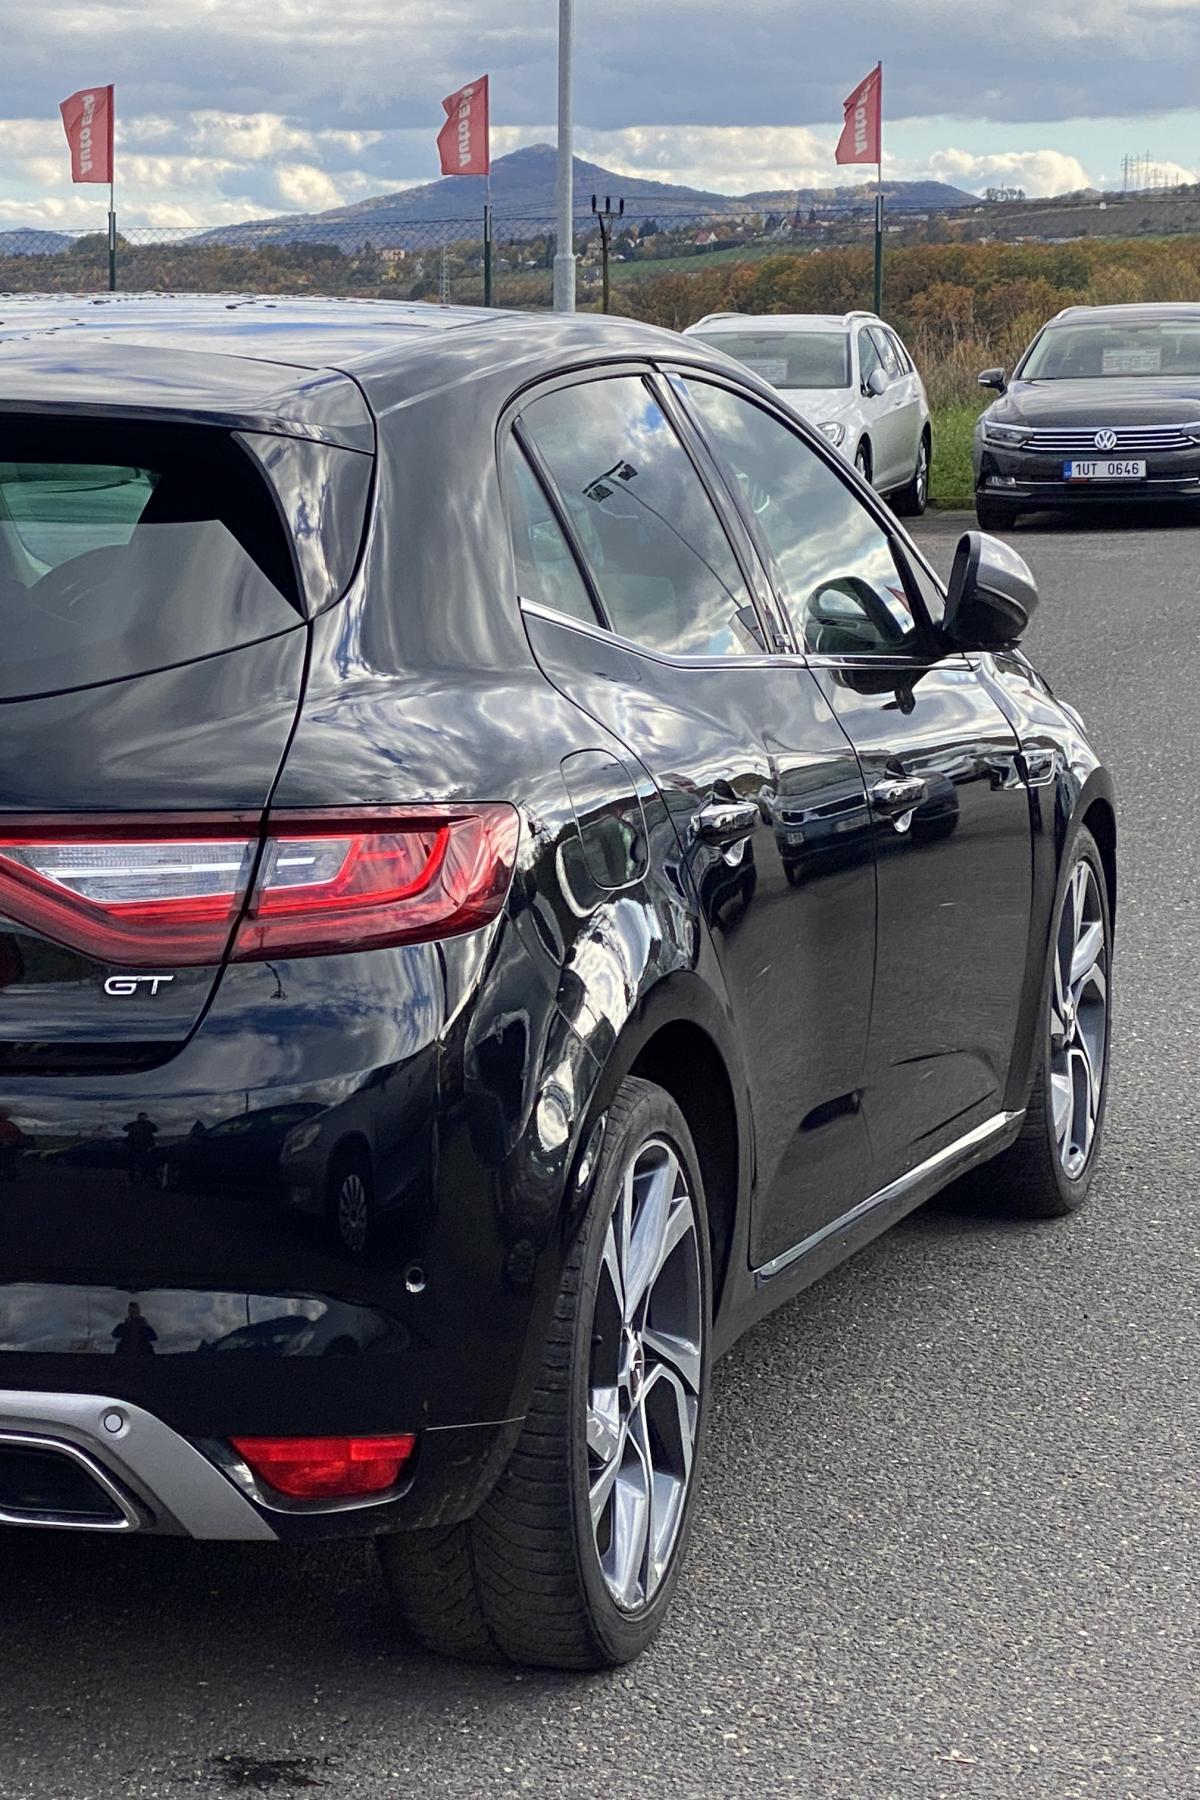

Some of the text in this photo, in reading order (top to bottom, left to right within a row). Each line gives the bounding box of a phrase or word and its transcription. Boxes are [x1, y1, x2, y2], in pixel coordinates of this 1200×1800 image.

[1076, 463, 1098, 475] 1UT
[1108, 463, 1139, 475] 0646
[104, 975, 174, 995] GT
